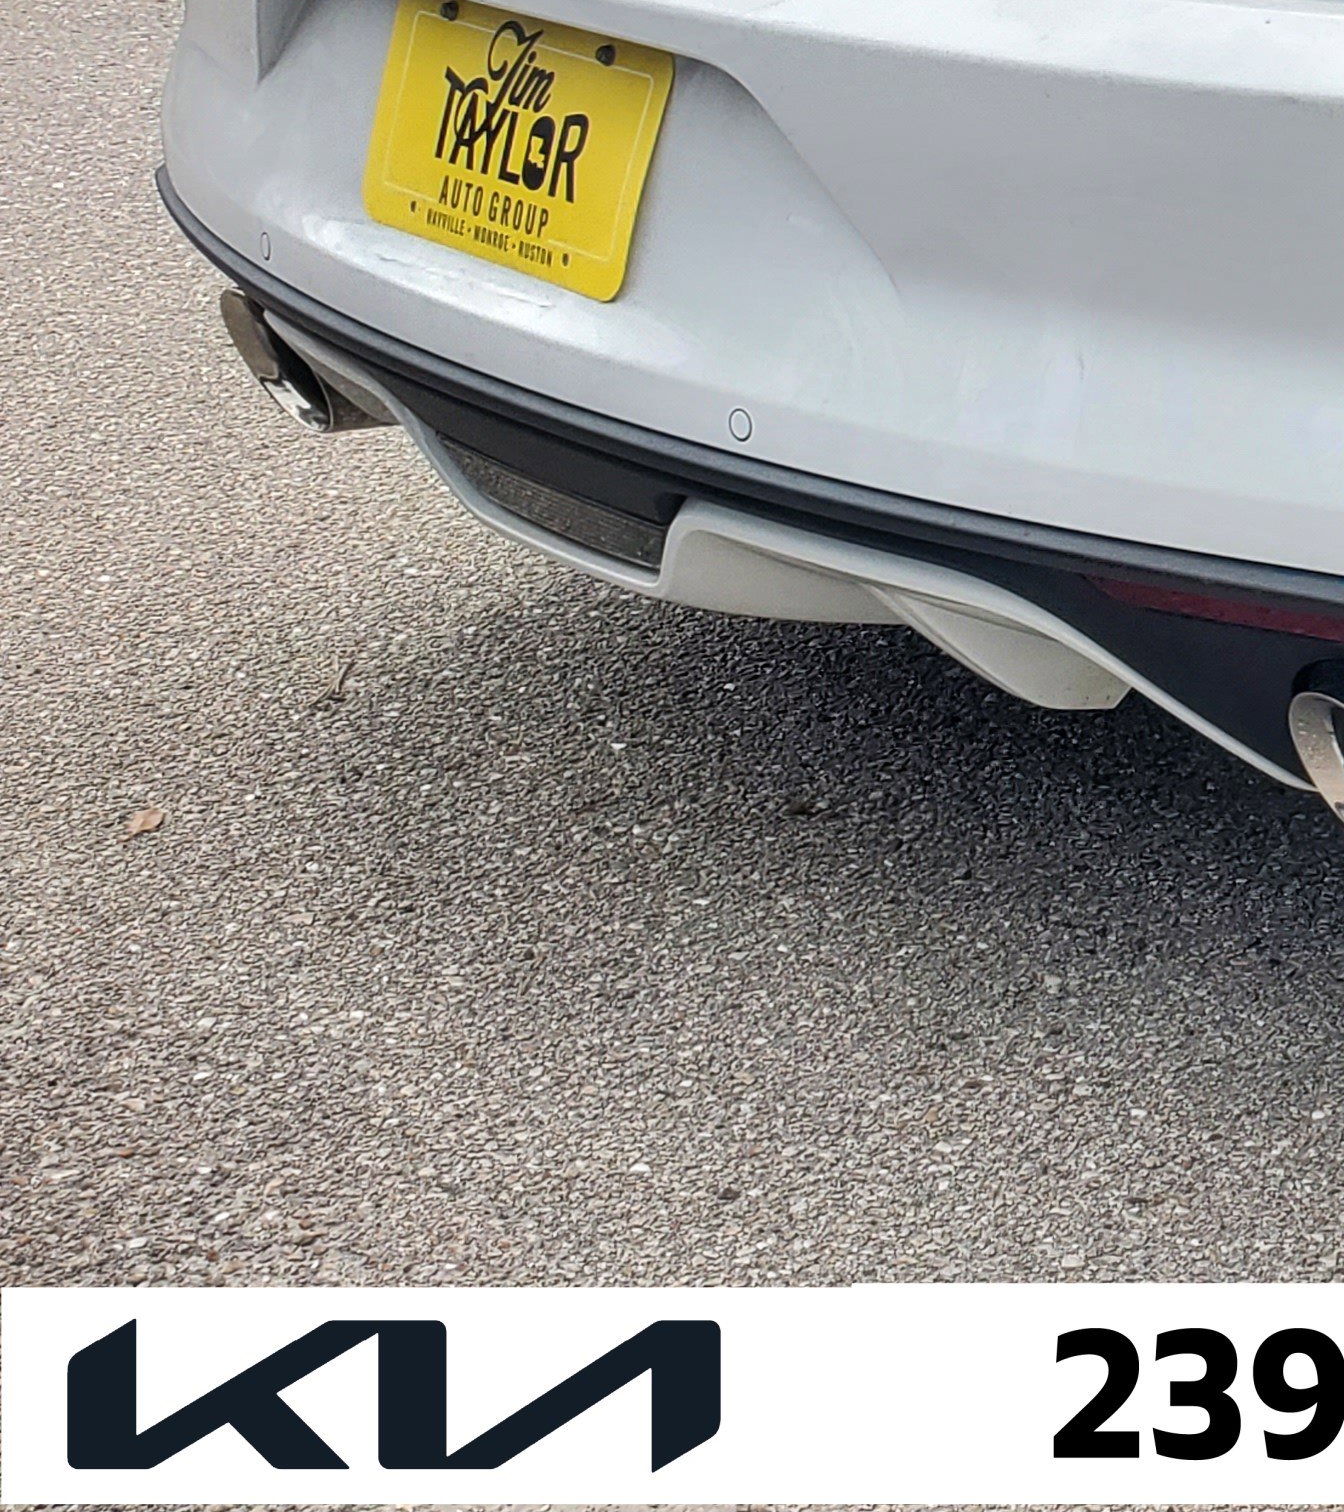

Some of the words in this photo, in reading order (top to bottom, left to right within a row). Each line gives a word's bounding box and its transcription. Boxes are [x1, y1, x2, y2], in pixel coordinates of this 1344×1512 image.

[434, 66, 589, 203] TAYLOR
[438, 174, 485, 217] AUTO
[488, 190, 550, 238] GROUP
[474, 225, 511, 253] MONROE
